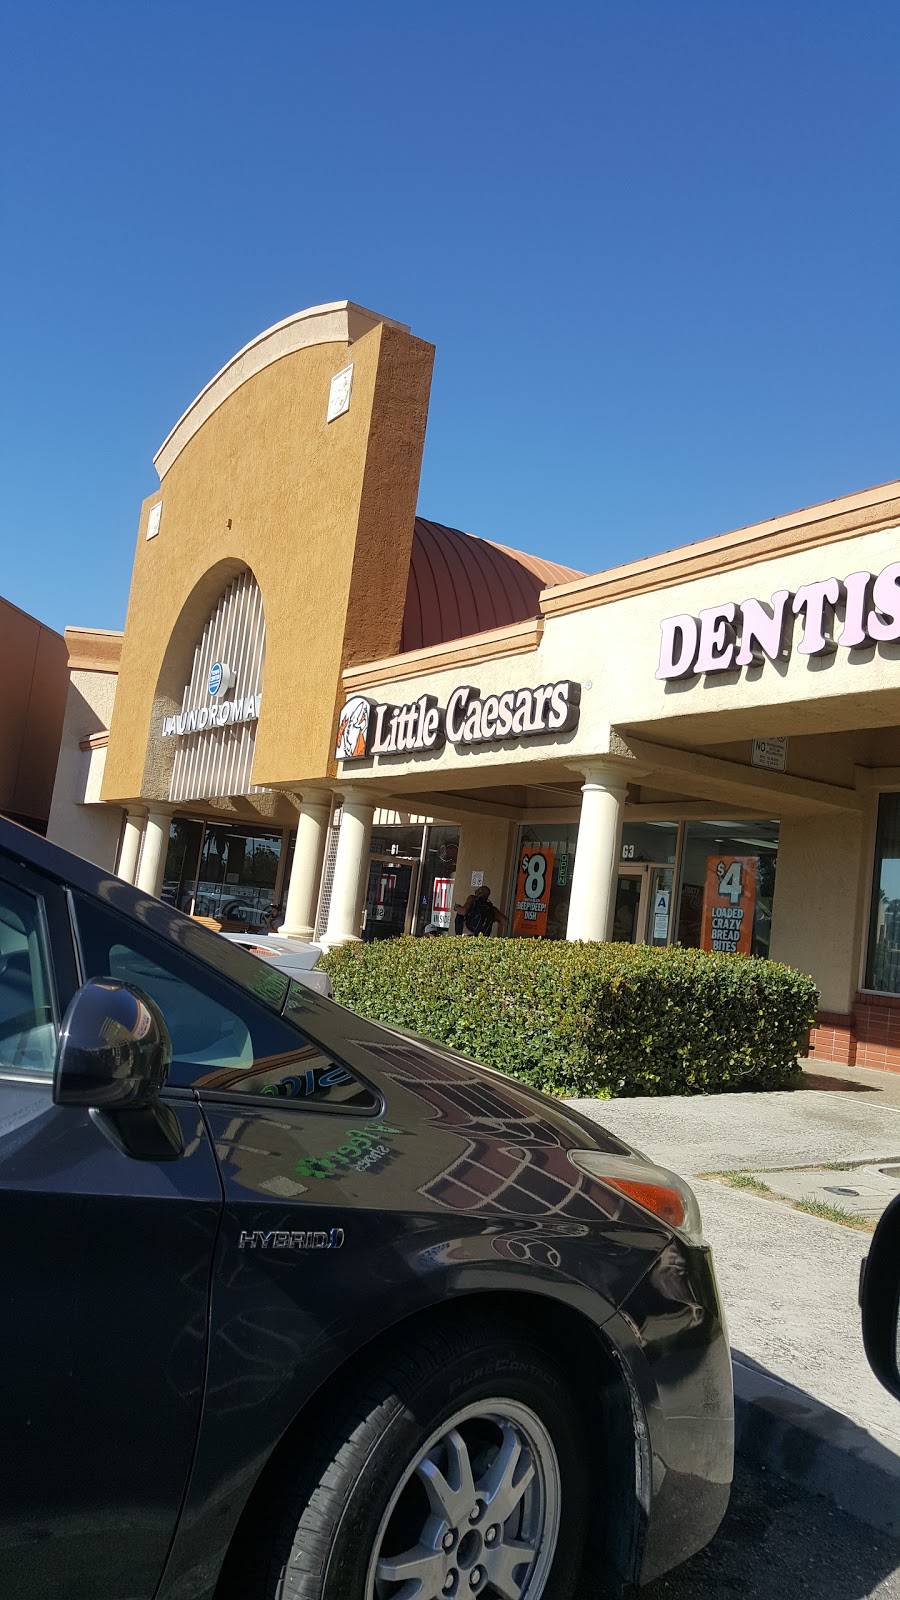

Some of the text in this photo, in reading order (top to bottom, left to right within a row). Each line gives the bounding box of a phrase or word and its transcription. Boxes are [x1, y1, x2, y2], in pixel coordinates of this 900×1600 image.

[370, 681, 570, 754] Little Caesars
[711, 907, 744, 919] LOADED
[711, 918, 742, 930] CRAZY
[711, 929, 740, 941] BREAD
[712, 940, 737, 952] BITES
[237, 1230, 330, 1249] HYBRID
